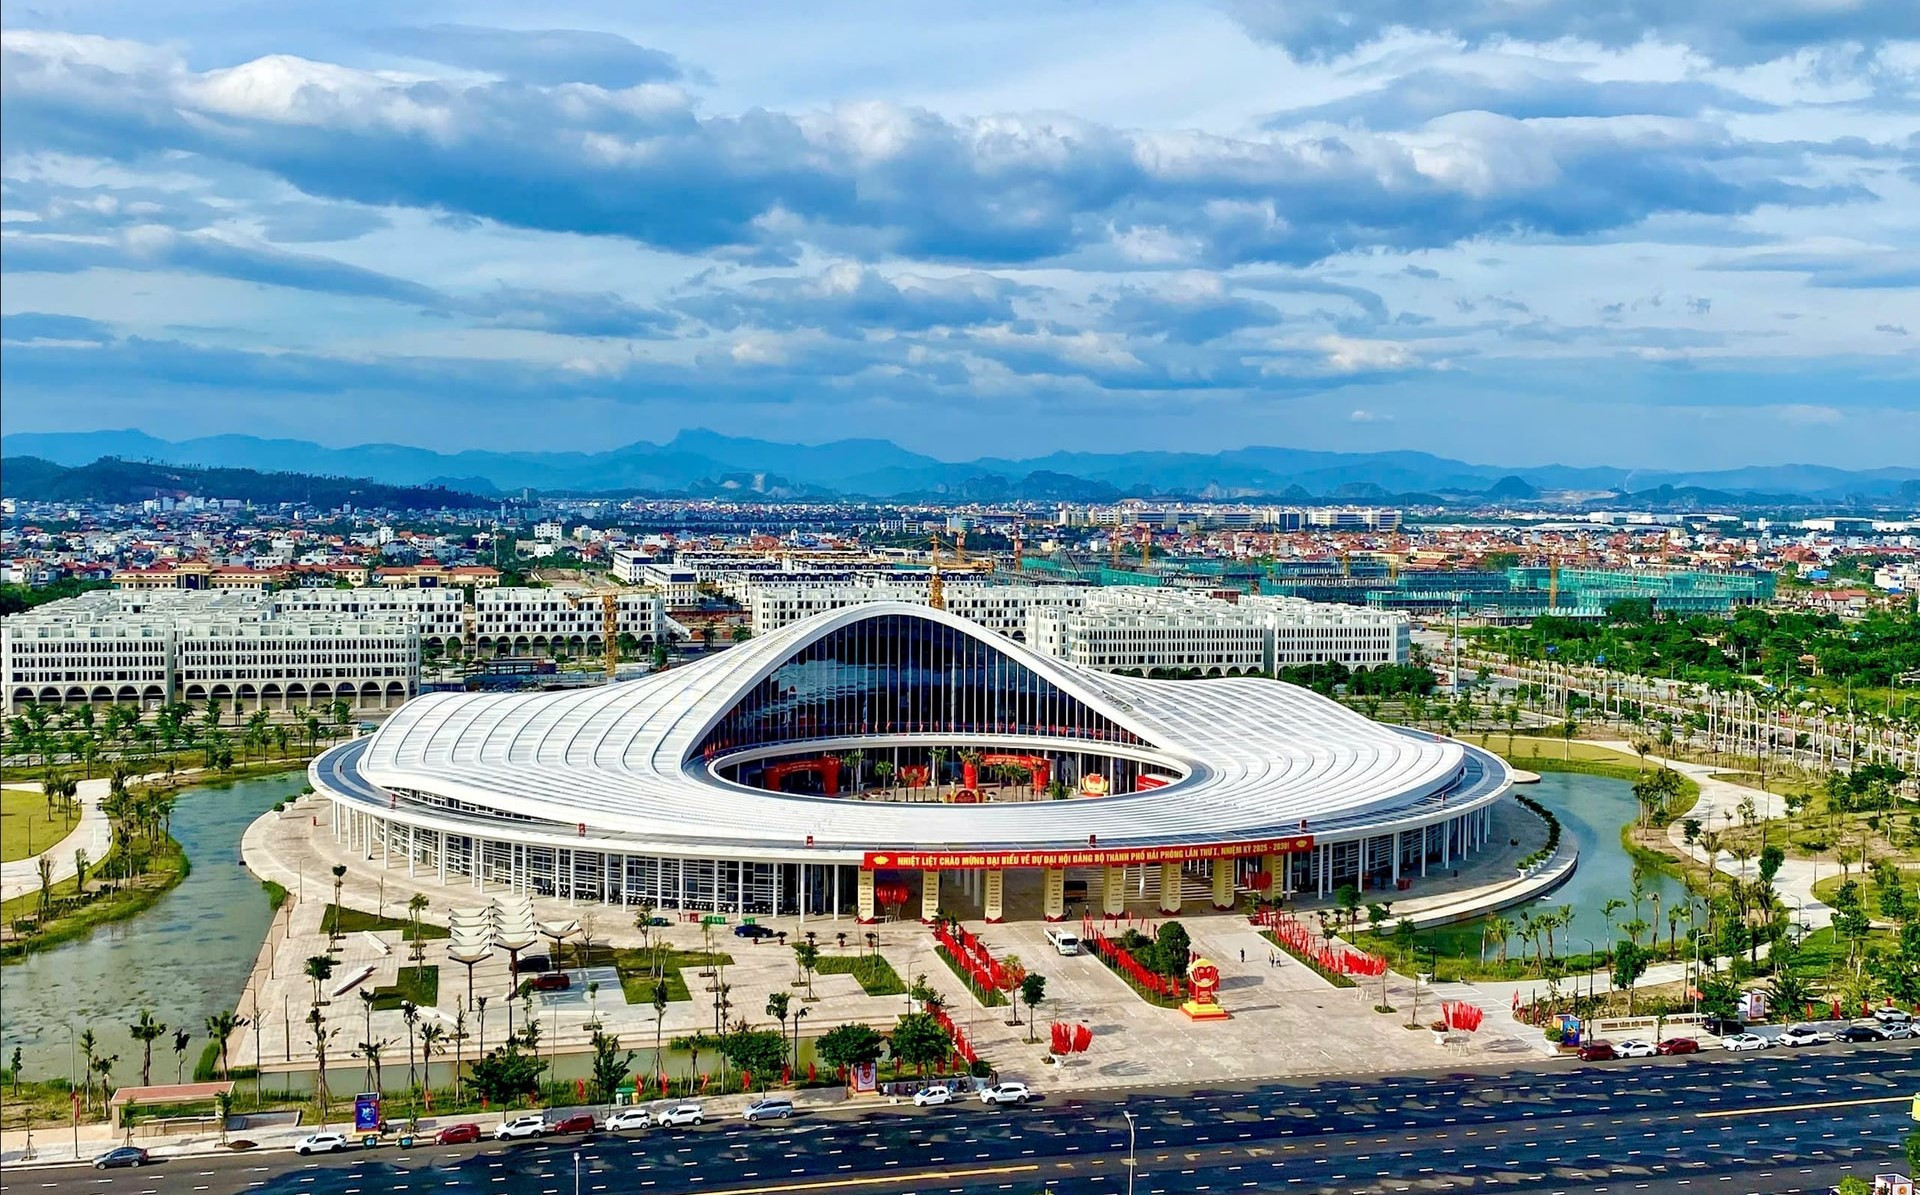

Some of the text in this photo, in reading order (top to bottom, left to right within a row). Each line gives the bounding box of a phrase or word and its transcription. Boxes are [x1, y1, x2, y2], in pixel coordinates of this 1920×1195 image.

[898, 855, 920, 867] NHIỆT
[922, 855, 937, 867] LIỆT
[939, 855, 960, 866] CHÀO
[1032, 854, 1043, 865] DỰ
[1058, 853, 1071, 865] HỘI
[1094, 852, 1104, 864] BỘ
[1106, 851, 1129, 862] THÀNH
[1130, 850, 1145, 861] PHỐ
[1146, 849, 1158, 860] HẢI
[1160, 848, 1183, 859] PHÒNG
[1221, 845, 1242, 856] NHIỆM
[1253, 843, 1268, 853] 2025
